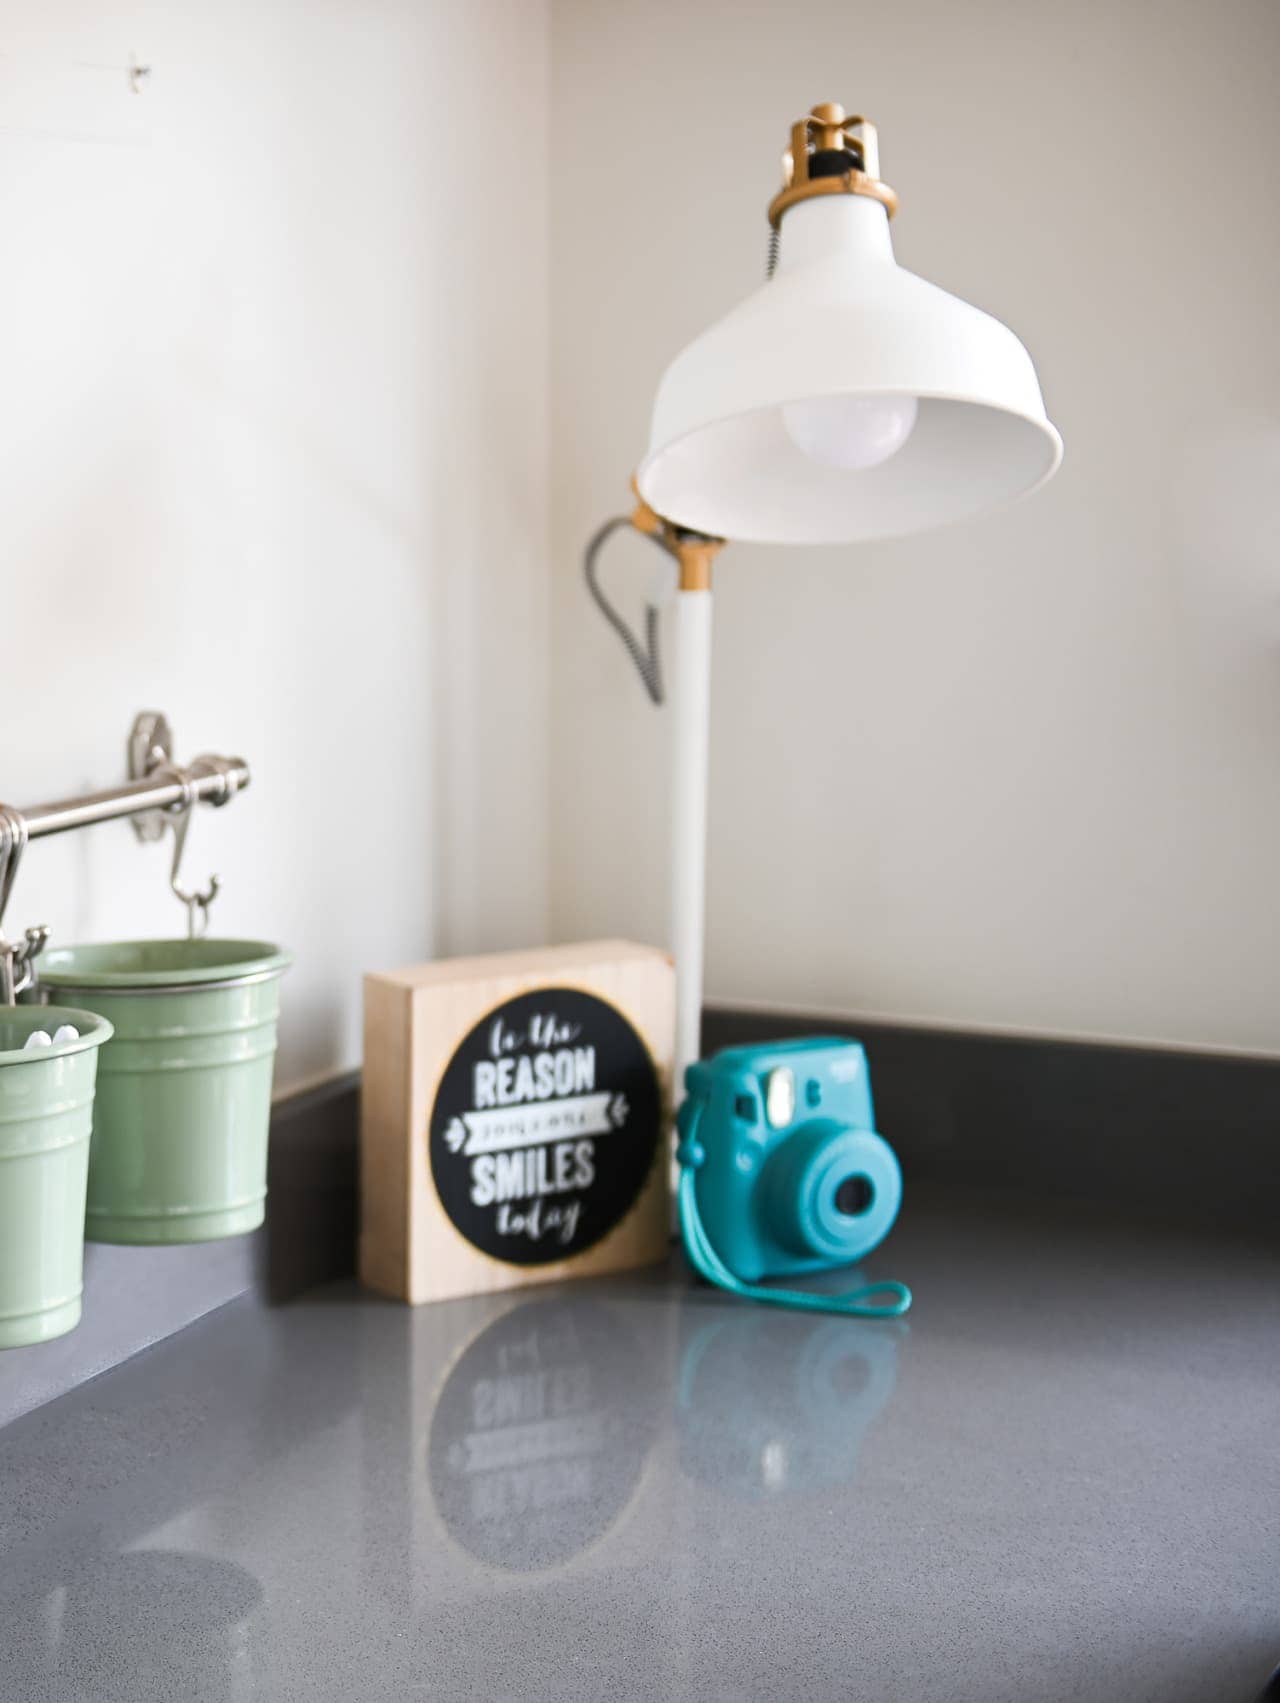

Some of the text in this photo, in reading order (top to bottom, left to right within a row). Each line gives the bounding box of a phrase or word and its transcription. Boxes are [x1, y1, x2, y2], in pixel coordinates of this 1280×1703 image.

[528, 1013, 581, 1047] the
[474, 1046, 596, 1109] REASON
[472, 1140, 596, 1206] SMILES
[496, 1200, 581, 1243] today
